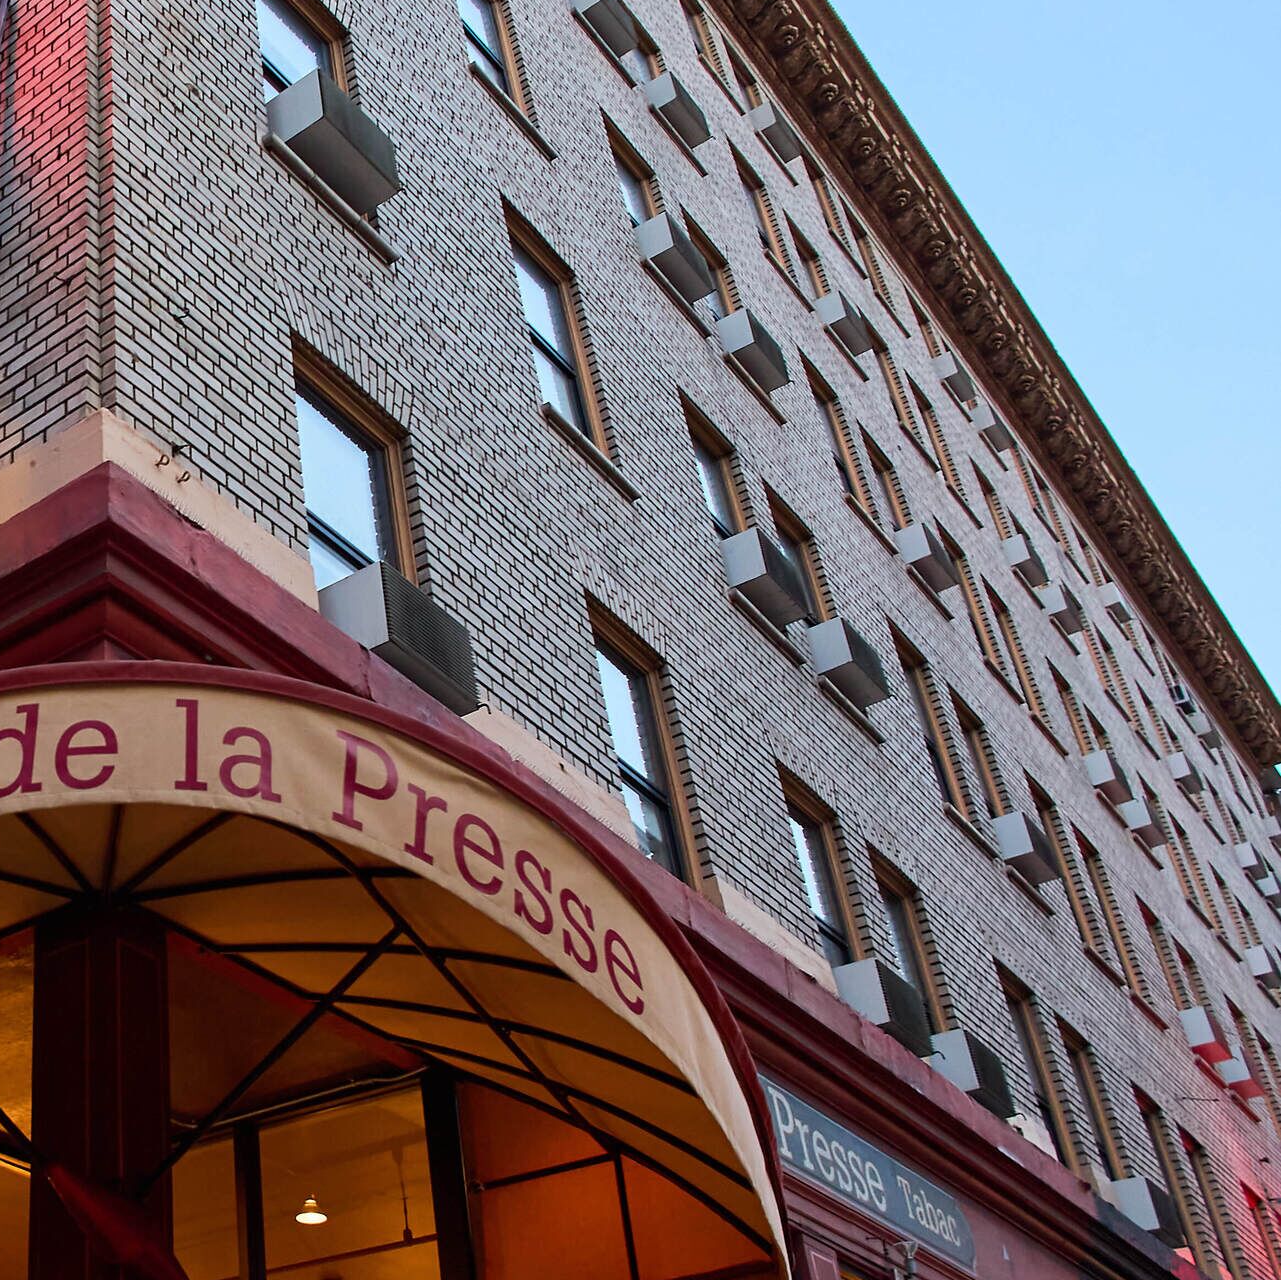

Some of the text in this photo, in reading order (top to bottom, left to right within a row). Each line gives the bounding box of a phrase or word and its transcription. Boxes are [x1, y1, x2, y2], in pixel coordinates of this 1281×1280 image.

[173, 699, 283, 804] la
[331, 729, 647, 1016] Presse
[768, 1086, 962, 1248] Presse Tabac
